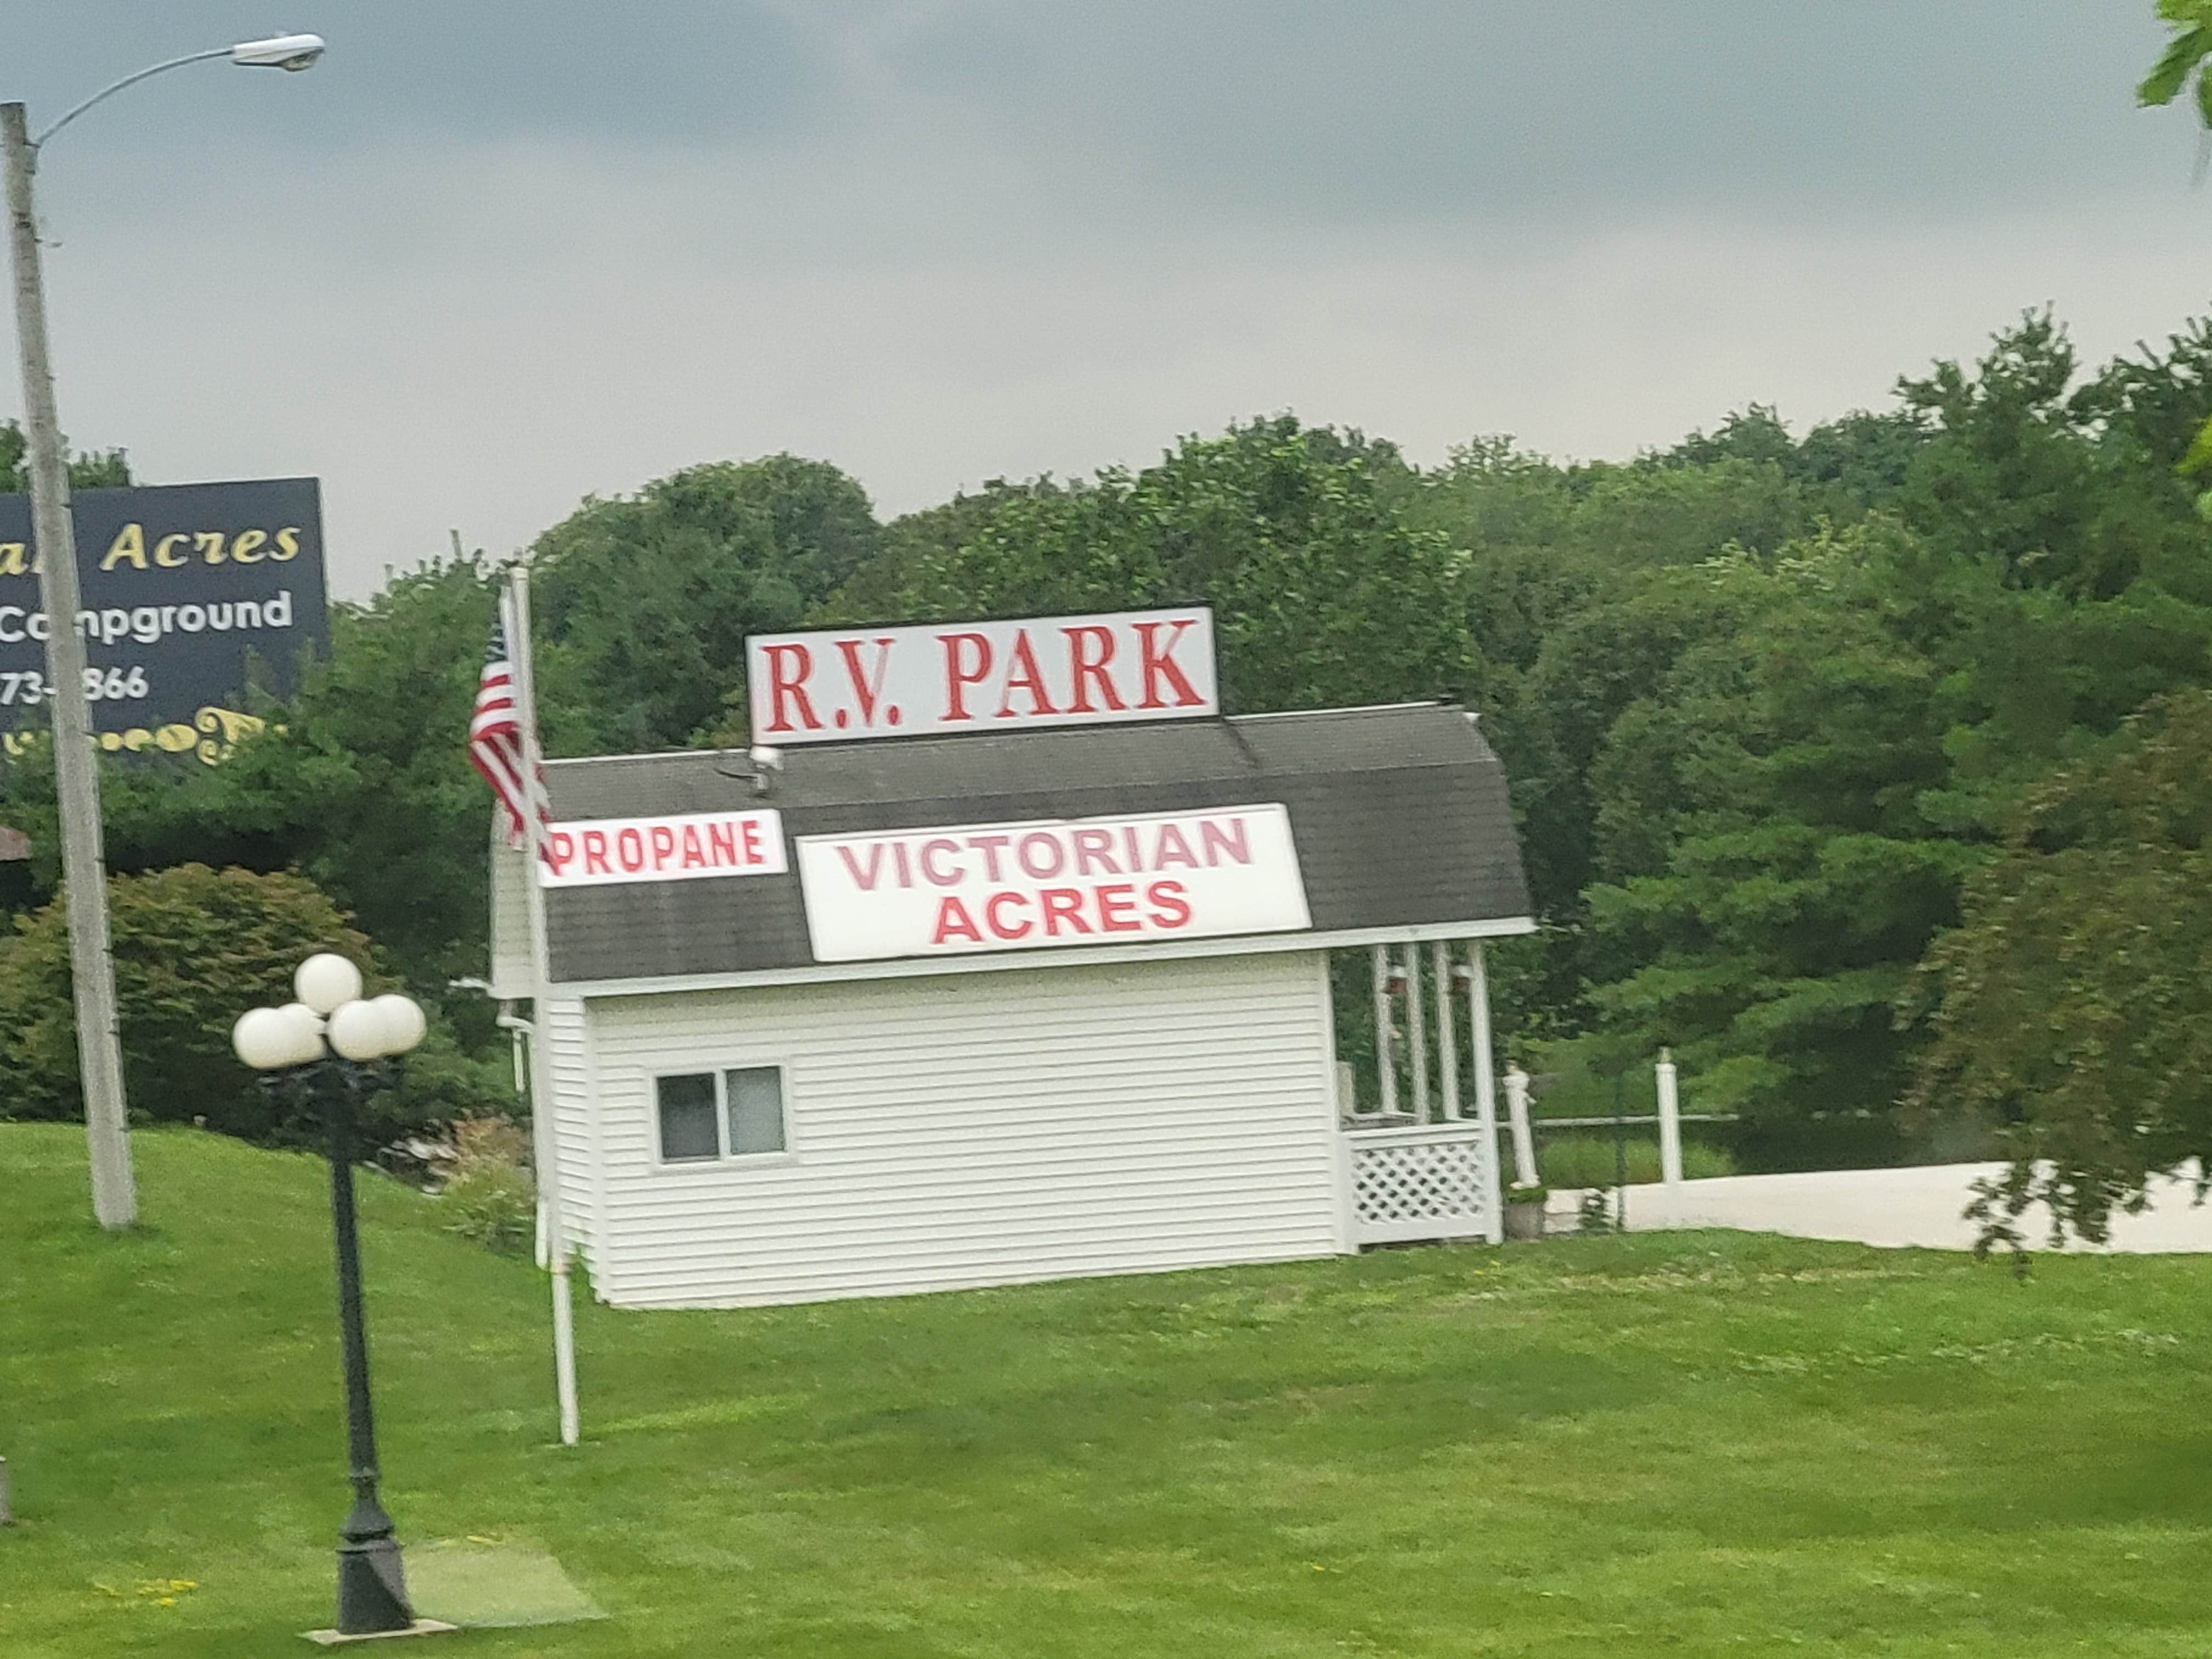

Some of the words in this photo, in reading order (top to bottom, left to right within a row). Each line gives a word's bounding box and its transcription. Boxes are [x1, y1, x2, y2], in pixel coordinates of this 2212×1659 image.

[99, 523, 301, 571] Acres
[0, 665, 149, 706] 73-866
[758, 637, 901, 732] R.V.
[936, 619, 1207, 722] PARK
[550, 820, 764, 876] PROPANE
[836, 817, 1252, 891] VICTORIAN
[930, 880, 1192, 945] ACRES
